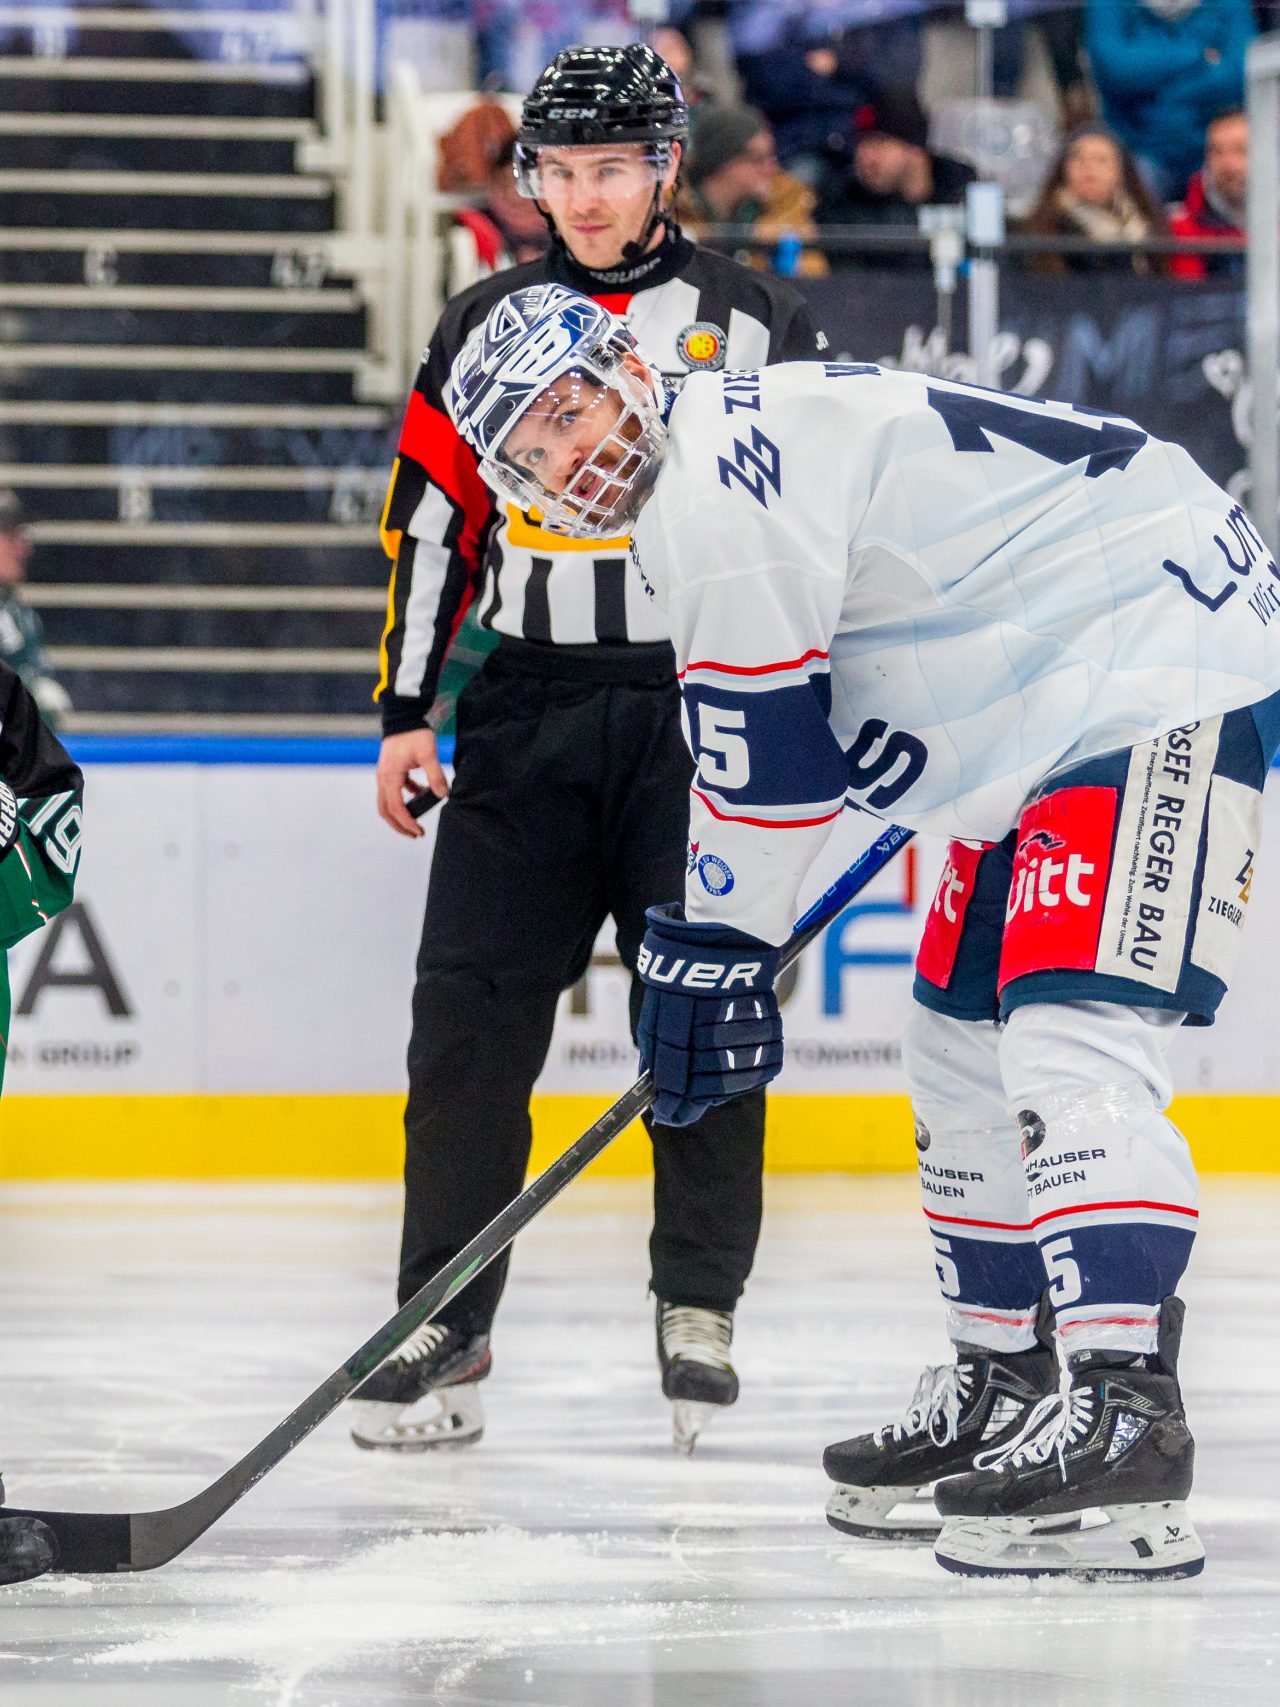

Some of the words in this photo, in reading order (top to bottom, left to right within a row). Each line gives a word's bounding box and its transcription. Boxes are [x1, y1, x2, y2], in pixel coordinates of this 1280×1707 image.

[547, 108, 598, 120] CCM
[698, 701, 751, 790] 5
[1142, 793, 1185, 895] REGER
[1130, 902, 1165, 972] BAU
